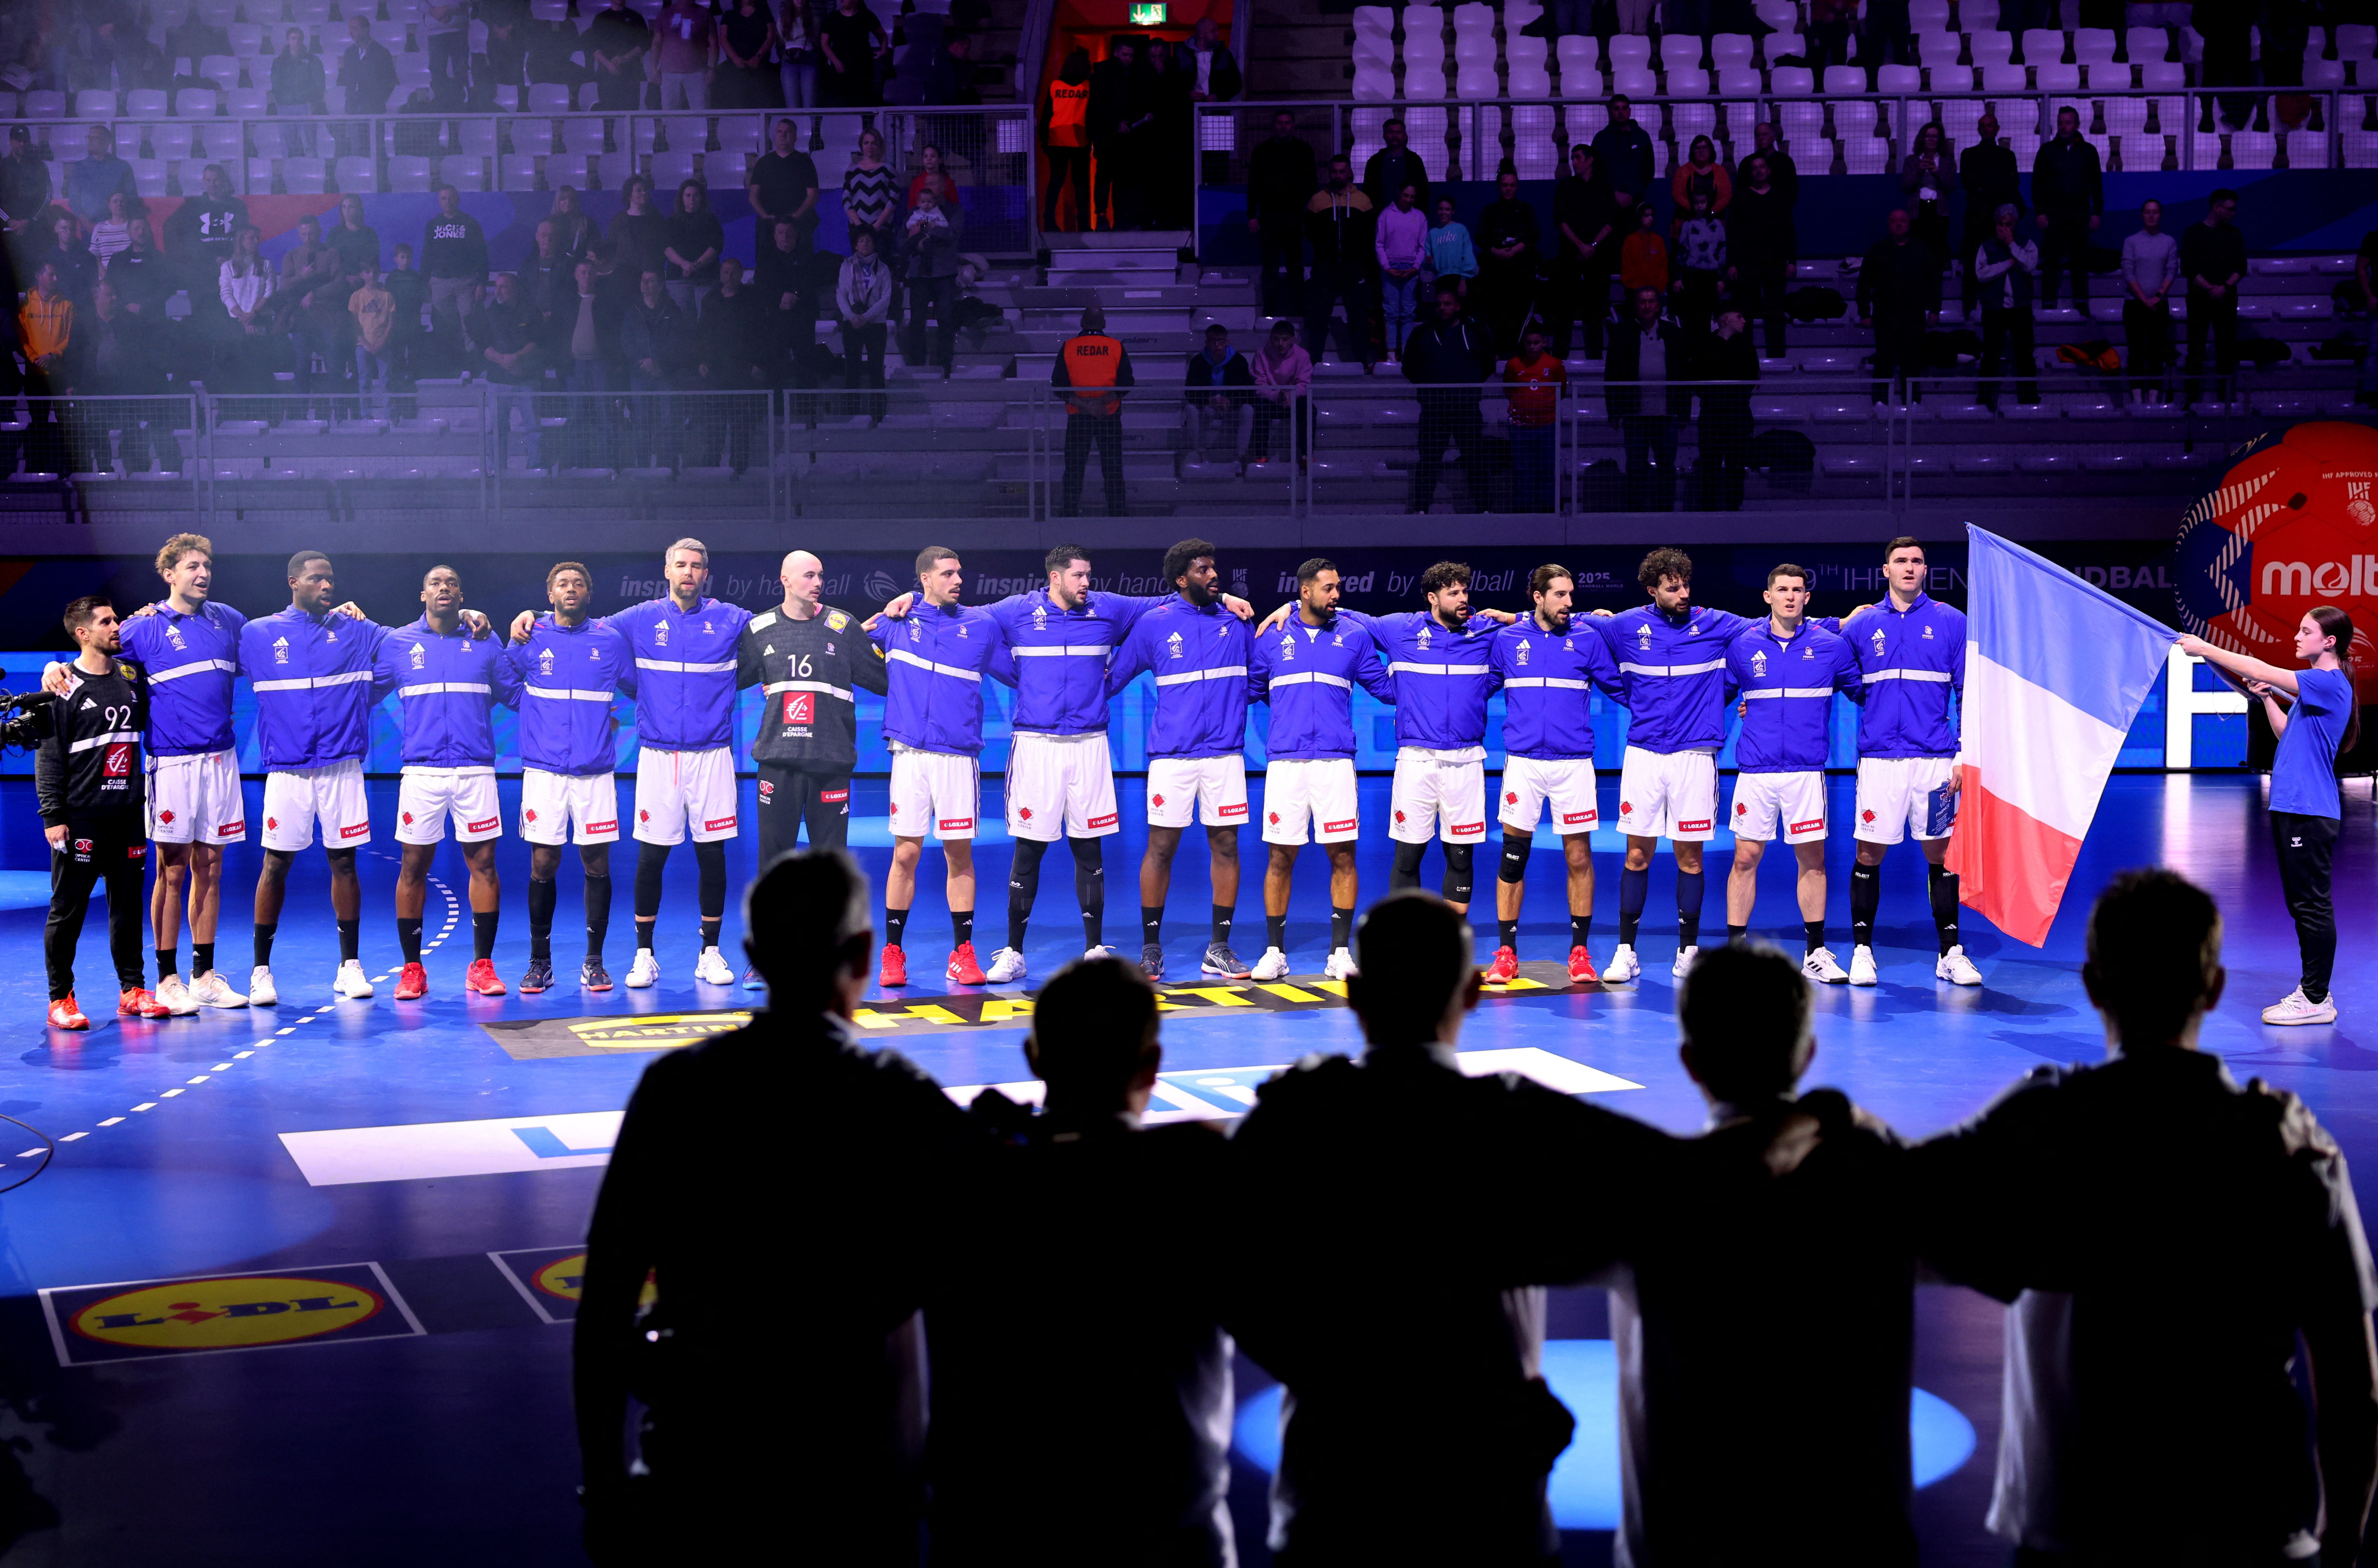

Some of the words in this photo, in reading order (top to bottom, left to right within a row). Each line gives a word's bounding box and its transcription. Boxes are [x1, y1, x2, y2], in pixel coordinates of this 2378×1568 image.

[1055, 89, 1090, 99] REDAR
[434, 231, 465, 239] JONES
[1077, 346, 1109, 356] REDAR
[620, 575, 714, 600] inspd
[726, 574, 753, 600] by
[1277, 571, 1375, 593] inred
[1387, 571, 1414, 597] by
[788, 654, 813, 677] 16
[105, 705, 131, 730] 92
[477, 820, 497, 829] LOXAM
[714, 819, 734, 828] LOXAM
[1097, 816, 1116, 825] LOXAM
[350, 825, 368, 833] LOXAM
[576, 1024, 740, 1040] HARTIN
